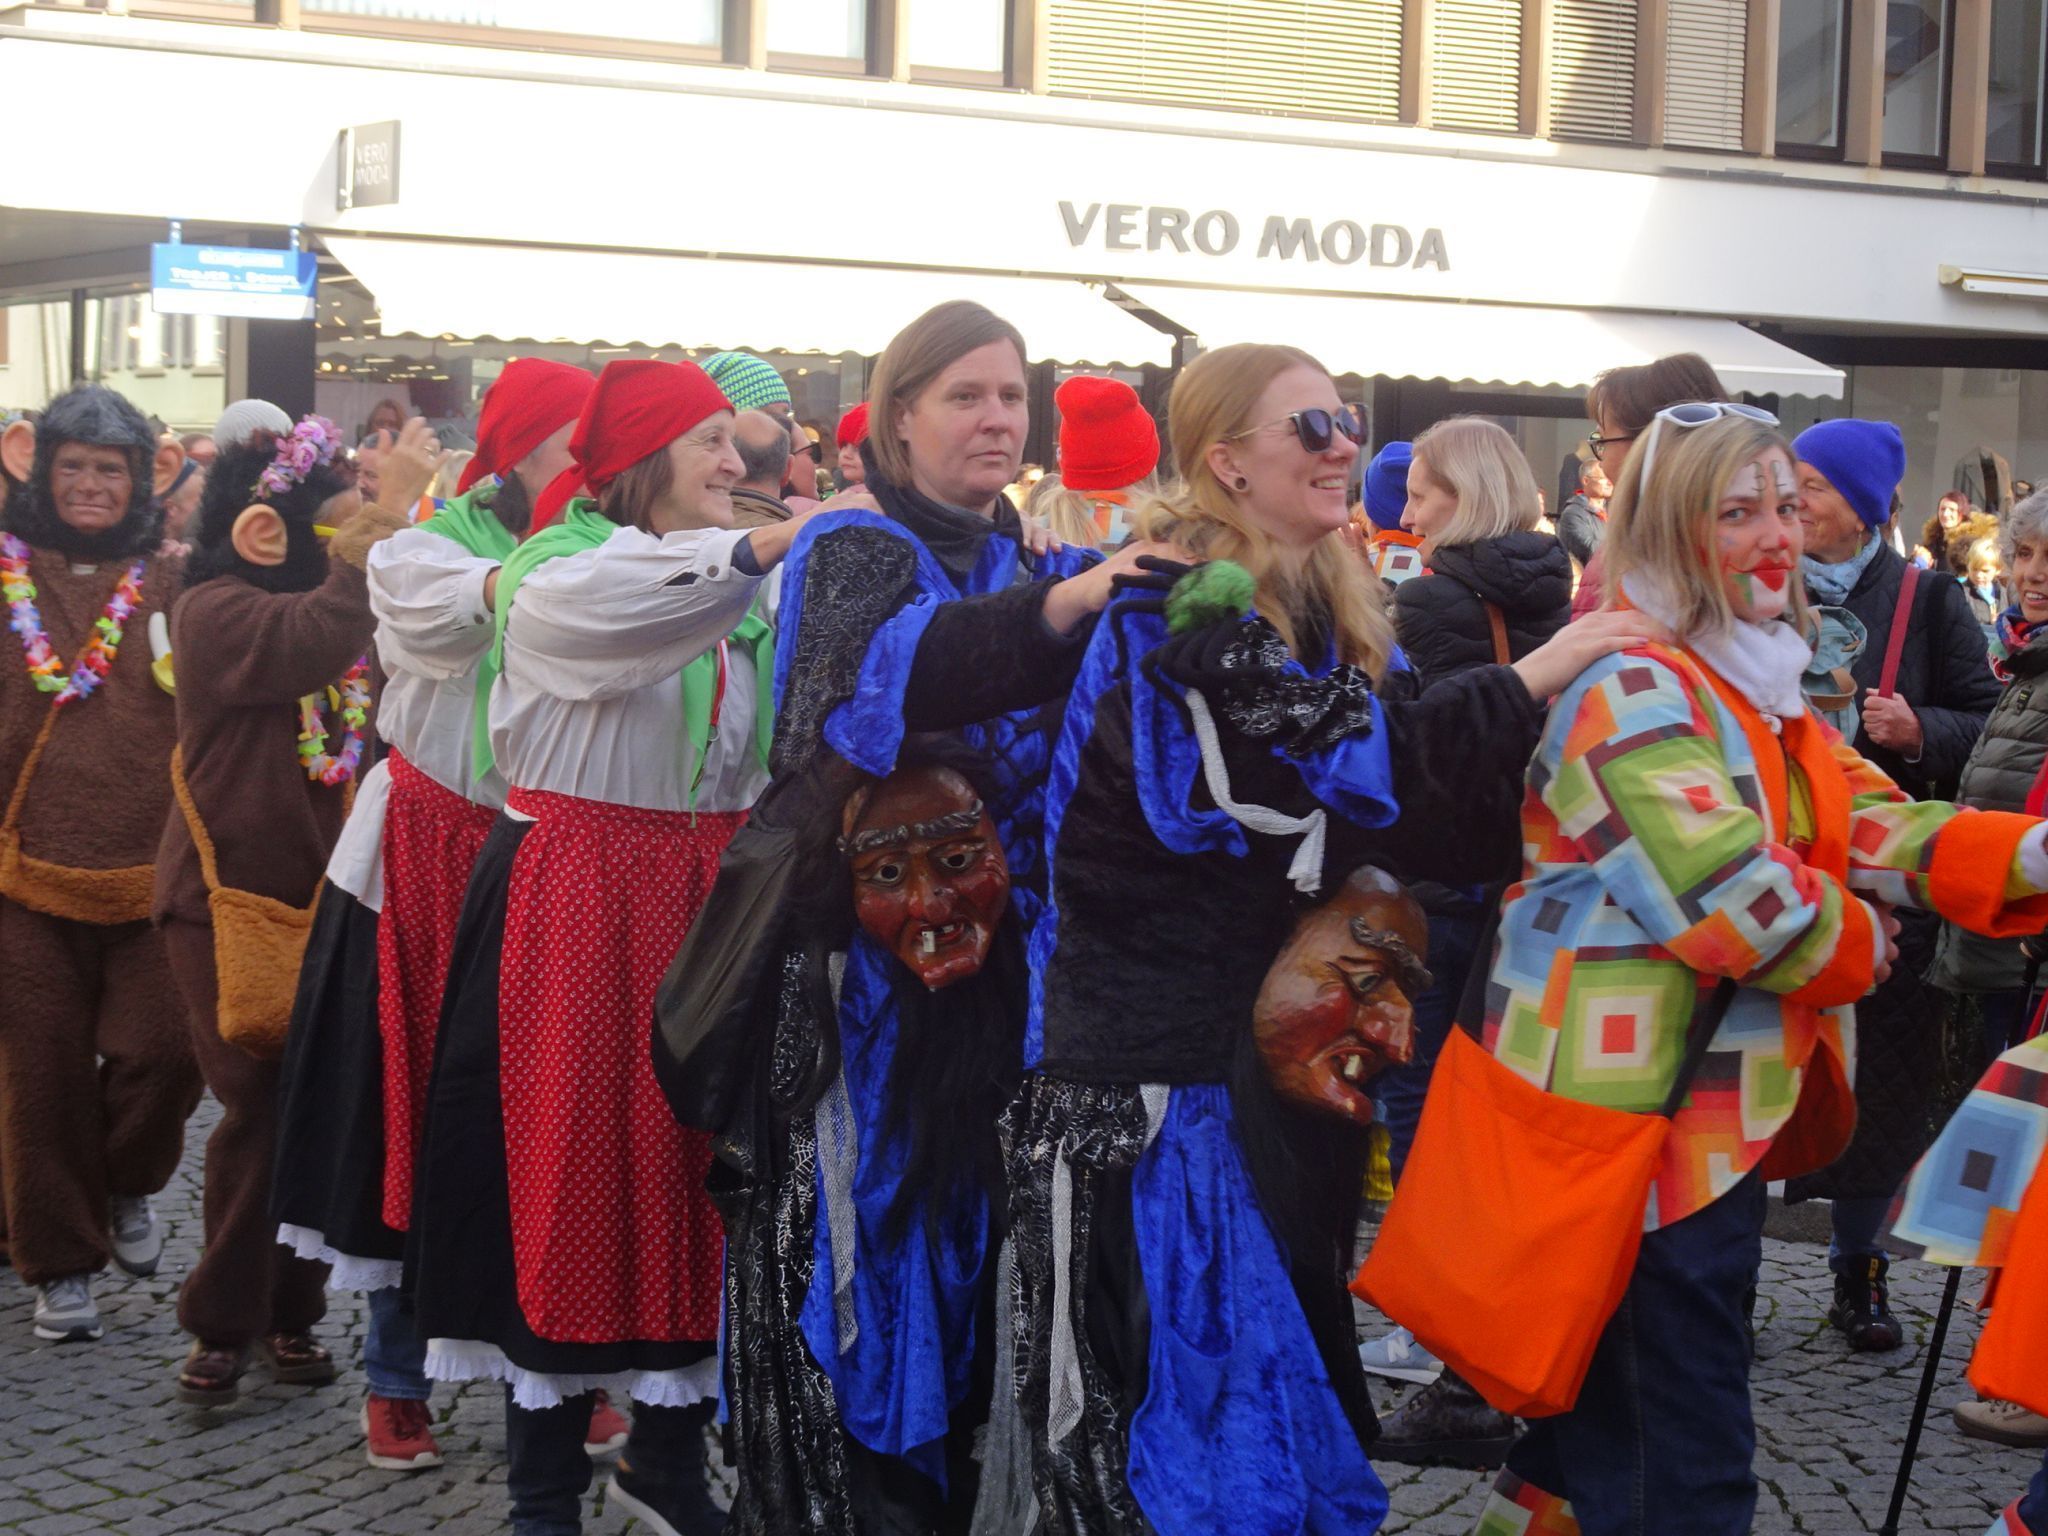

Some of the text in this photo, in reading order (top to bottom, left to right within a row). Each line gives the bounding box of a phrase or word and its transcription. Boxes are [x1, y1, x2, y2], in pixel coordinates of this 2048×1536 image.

[355, 141, 388, 164] VERO
[1057, 200, 1451, 272] VERO MODA
